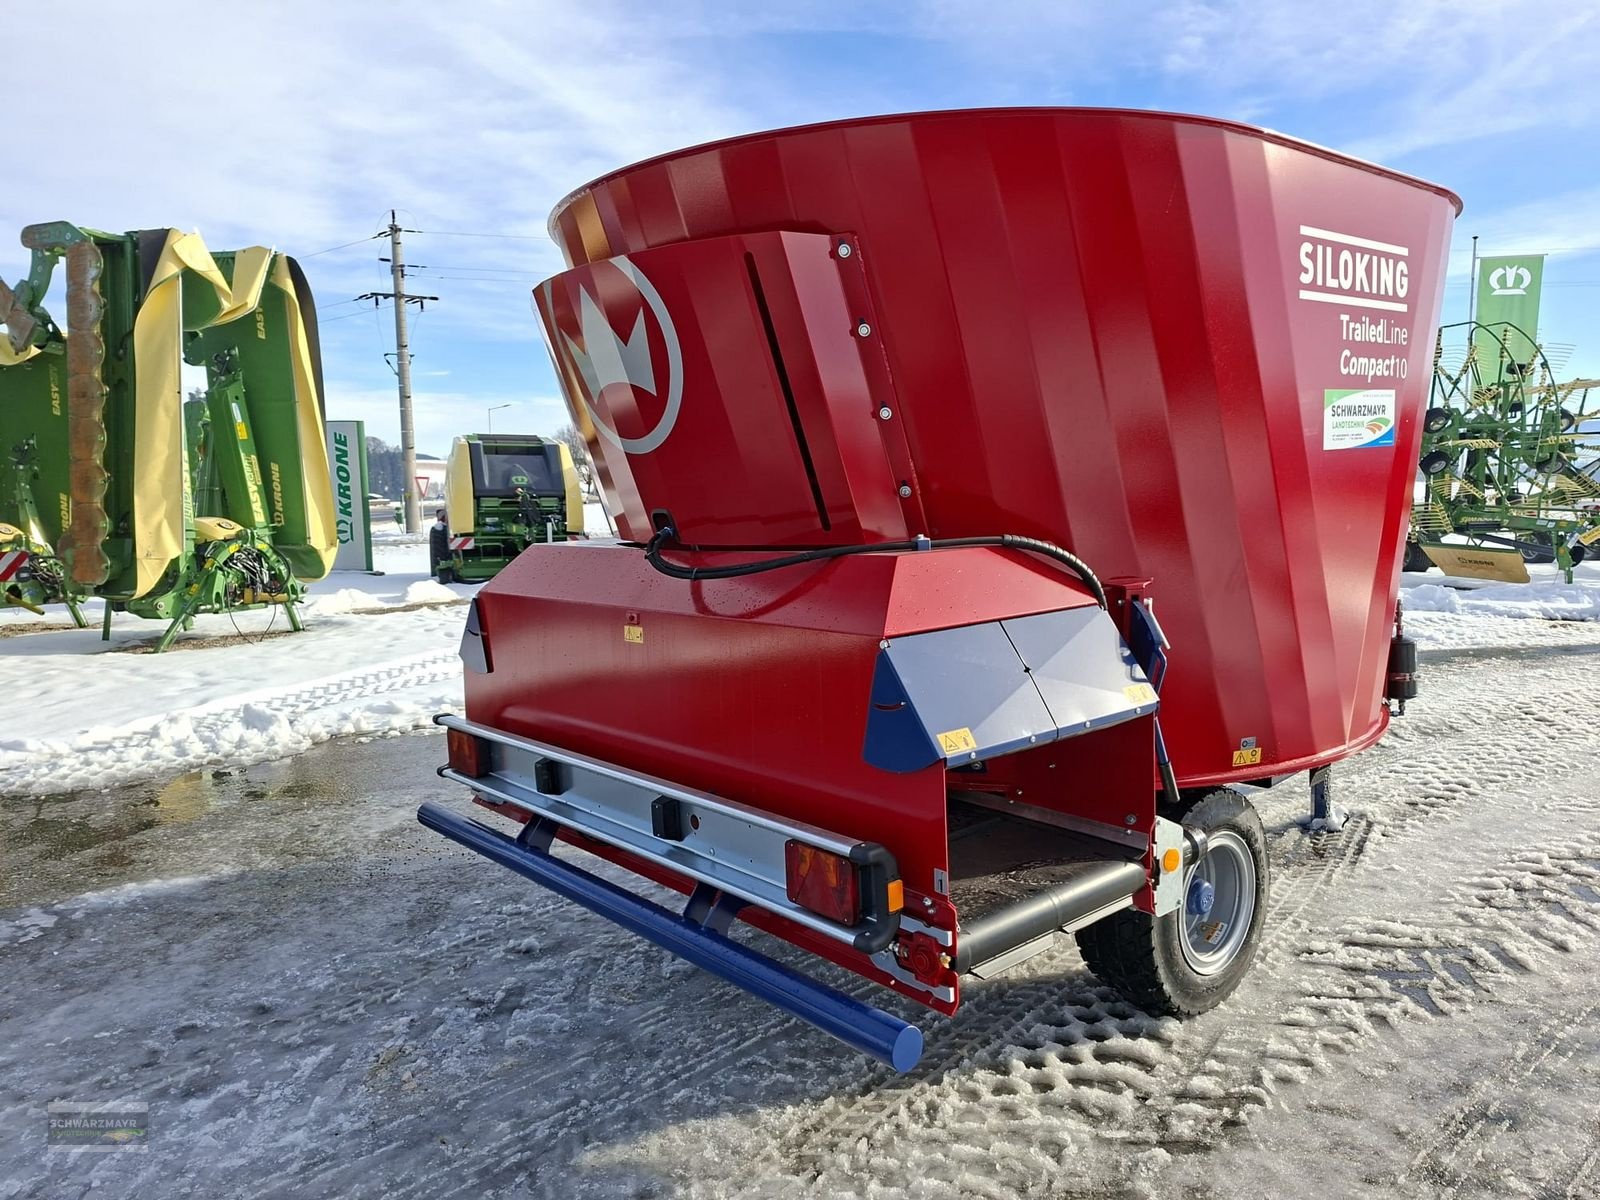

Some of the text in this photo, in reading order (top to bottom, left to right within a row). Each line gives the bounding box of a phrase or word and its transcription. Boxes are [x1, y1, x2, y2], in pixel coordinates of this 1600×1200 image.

[1299, 241, 1408, 298] SILOKING
[1340, 313, 1408, 345] TrailedLine
[1331, 404, 1386, 417] SCHWARZMAYR
[1332, 420, 1365, 429] LANDTECHNIK
[270, 462, 284, 513] KRONE
[333, 431, 352, 518] KRONE
[59, 492, 68, 532] RONE
